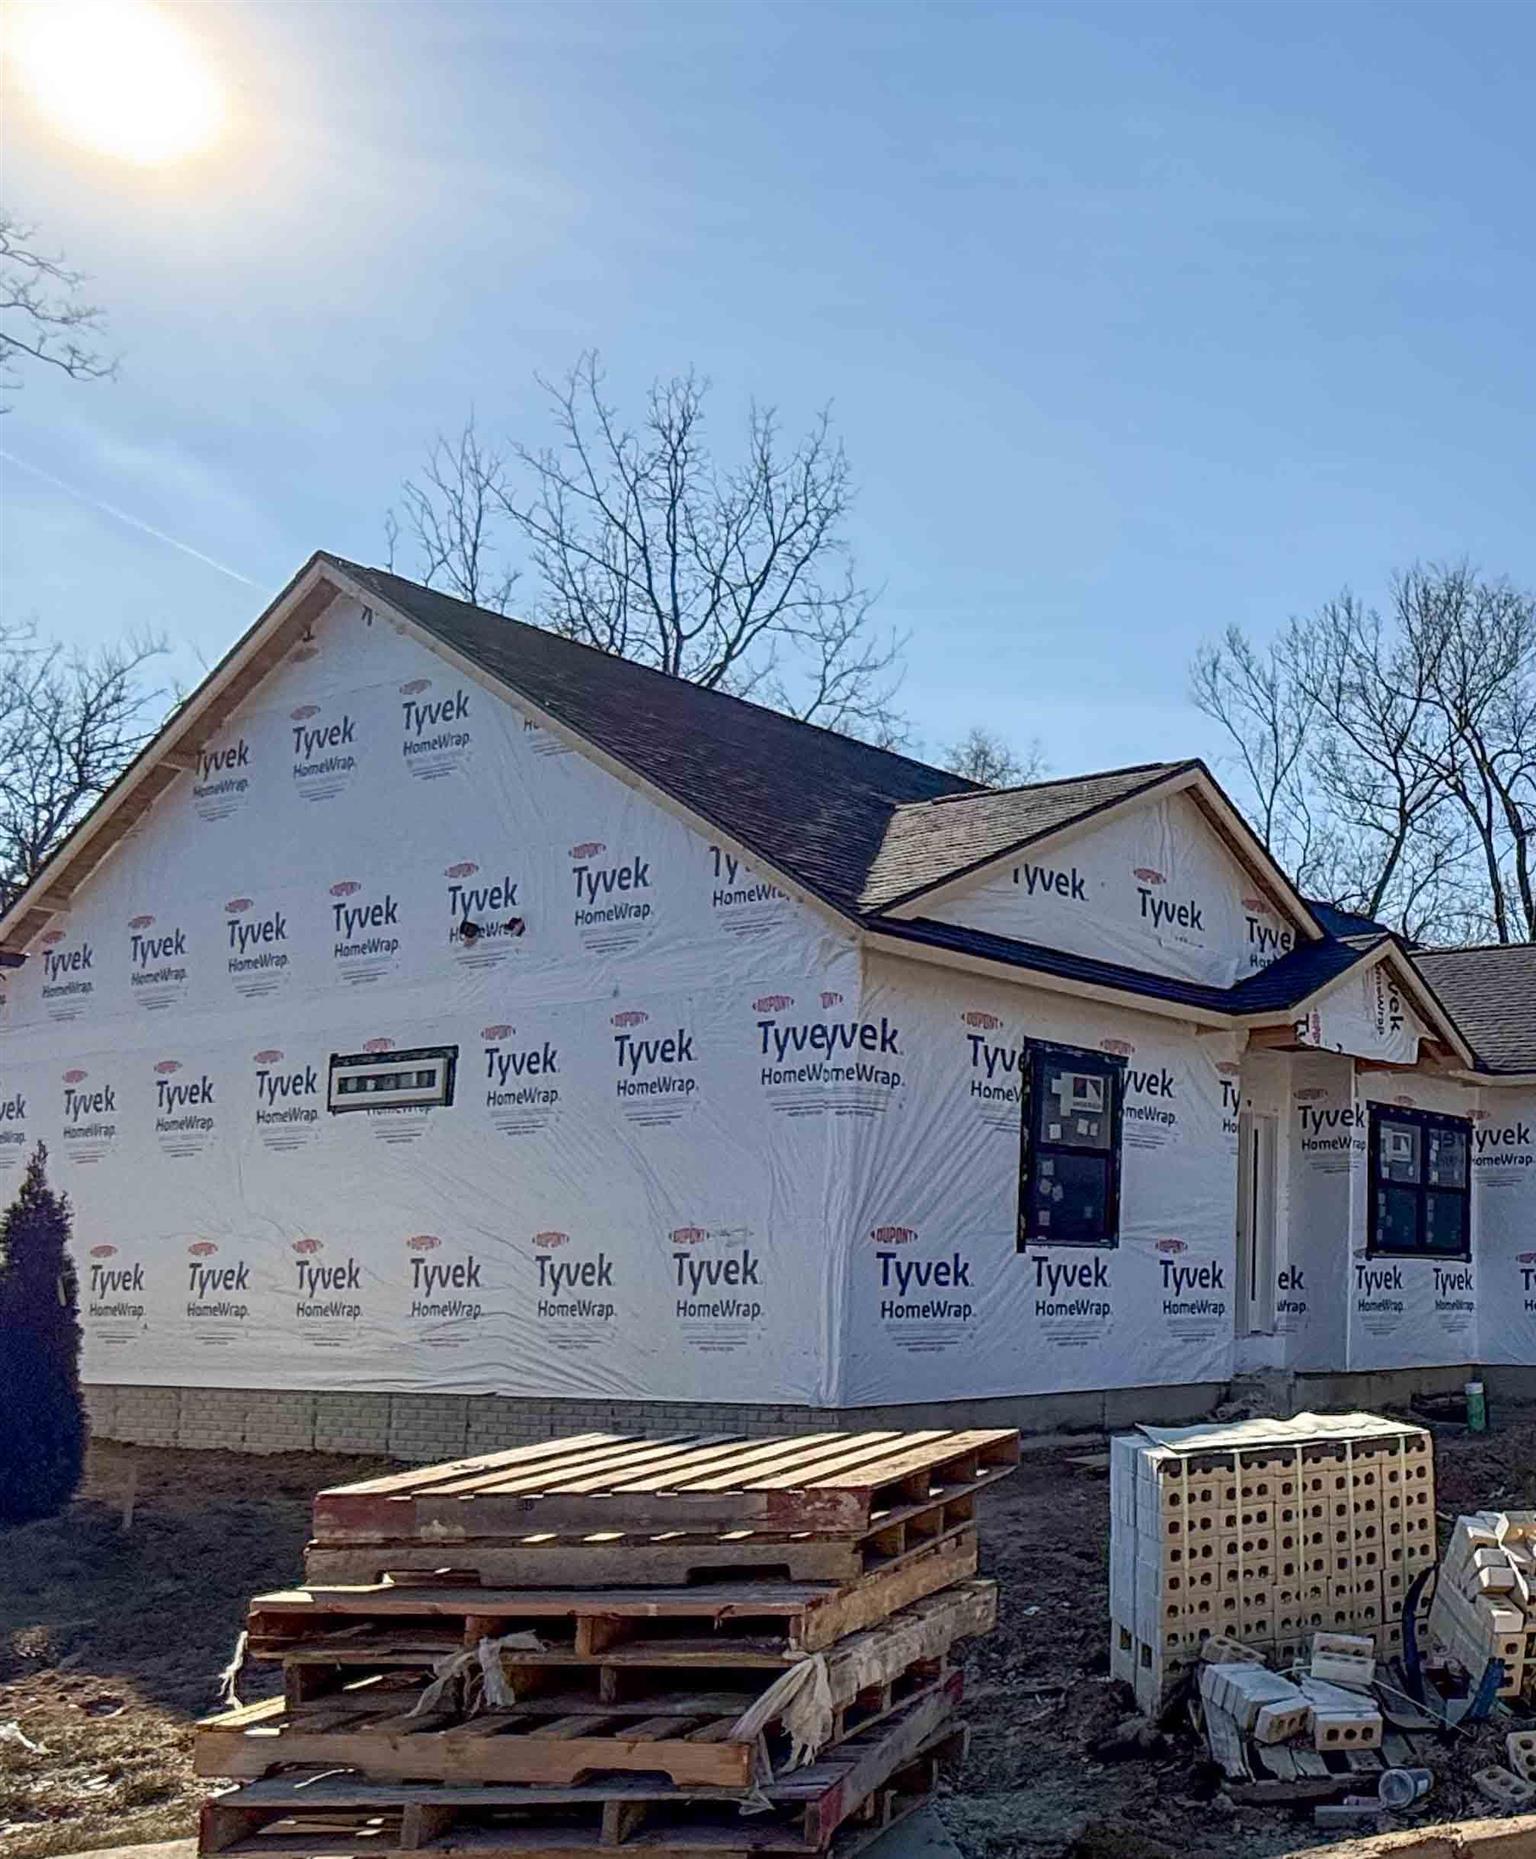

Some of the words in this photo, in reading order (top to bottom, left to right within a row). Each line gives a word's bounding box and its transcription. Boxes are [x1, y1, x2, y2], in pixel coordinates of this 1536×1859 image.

[403, 690, 469, 735] Tyvek
[293, 716, 355, 760] Tyvek
[403, 731, 470, 757] HomeWrap
[293, 755, 354, 779] HomeWrap
[573, 856, 650, 904] Tyvek
[448, 875, 518, 922] Tyvek
[574, 901, 650, 926] HomeWrap
[1137, 887, 1203, 931] Tyvek
[333, 895, 398, 939] Tyvek
[131, 928, 187, 968] Tyvek
[227, 912, 287, 954] Tyvek
[334, 937, 398, 959] HomeWrap
[42, 943, 93, 981] Tyvek
[131, 966, 187, 986] HomeWrap
[228, 952, 288, 973] HomeWrap
[485, 1042, 558, 1086] Tyvek
[615, 1028, 693, 1076] Tyvek
[156, 1076, 213, 1114] Tyvek
[256, 1065, 317, 1106] Tyvek
[486, 1088, 559, 1107] HomeWrap
[616, 1076, 695, 1097] HomeWrap
[64, 1085, 115, 1122] Tyvek
[257, 1107, 317, 1124] HomeWrap
[1298, 1103, 1365, 1135] Tyvek
[156, 1115, 213, 1133] HomeWrap
[1471, 1122, 1530, 1153] yvek
[1473, 1153, 1533, 1166] omeWrap
[876, 1227, 914, 1243] DUPONT
[90, 1263, 144, 1299] Tyvek
[189, 1261, 249, 1299] Tyvek
[296, 1258, 360, 1298] Tyvek
[411, 1256, 480, 1297] Tyvek
[535, 1253, 612, 1296] Tyvek
[673, 1250, 758, 1296] Tyvek
[876, 1252, 969, 1296] Tyvek
[1032, 1256, 1108, 1296] Tyvek
[1160, 1260, 1223, 1297] Tyvek
[1356, 1265, 1402, 1296] Tyvek
[1433, 1268, 1473, 1296] Tyvek
[90, 1303, 144, 1317] HomeWrap
[187, 1302, 247, 1319] HomeWrap
[297, 1301, 360, 1319] HomeWrap
[411, 1300, 481, 1319] HomeWrap
[538, 1300, 614, 1320] HomeWrap
[676, 1300, 761, 1320] HomeWrap
[881, 1301, 972, 1321] HomeWrap
[1036, 1299, 1110, 1318] HomeWrap
[1163, 1300, 1225, 1316] HomeWrap
[1358, 1299, 1403, 1314] HomeWrap
